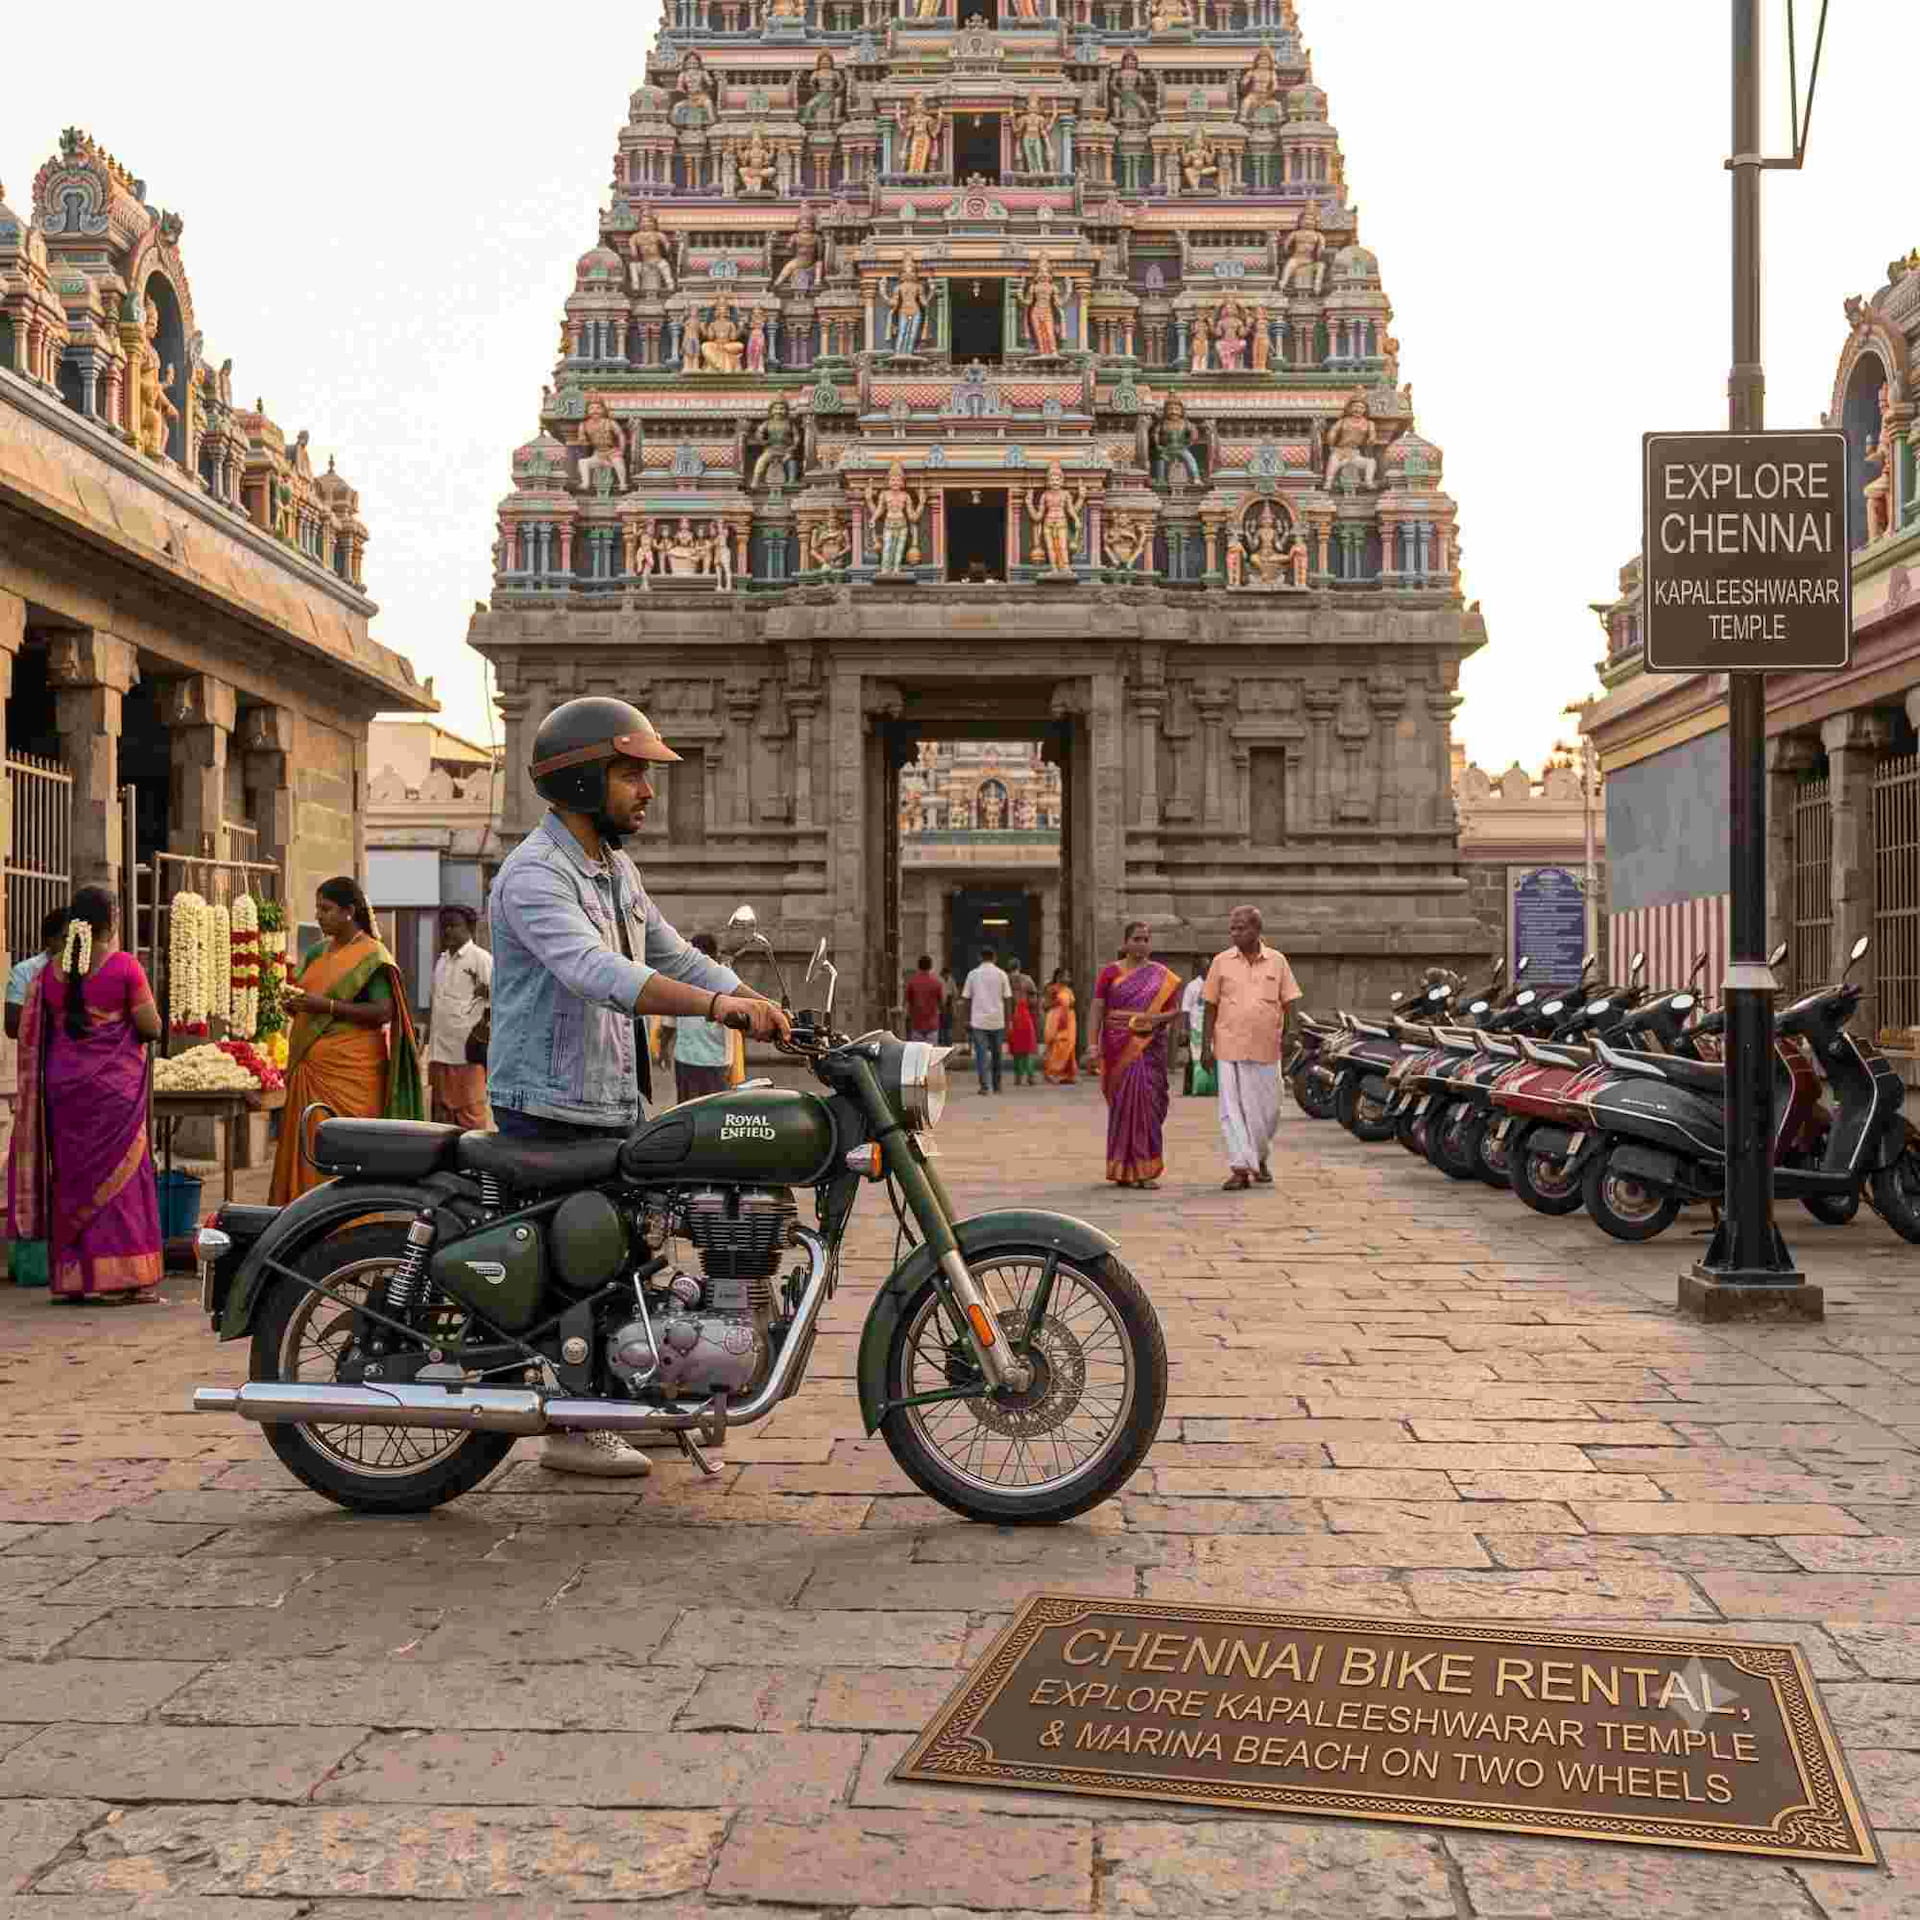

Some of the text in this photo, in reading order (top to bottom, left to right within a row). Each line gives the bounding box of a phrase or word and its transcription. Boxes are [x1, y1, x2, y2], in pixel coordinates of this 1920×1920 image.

[1664, 462, 1829, 500] EXPLORE
[1660, 511, 1833, 554] CHENNAI
[1654, 578, 1841, 606] KAPALEESHWARAR
[1708, 613, 1787, 641] TEMPLE
[720, 1126, 776, 1141] ENFIELD
[725, 1112, 770, 1127] ROYAL
[1062, 1627, 1752, 1722] CHENNAI BIKE RENTAL,
[1029, 1678, 1760, 1763] EXPLORE KAPALEESHWARAR TEMPLE
[1038, 1718, 1734, 1805] & MARINA BEACH ON TWO WHEELS
